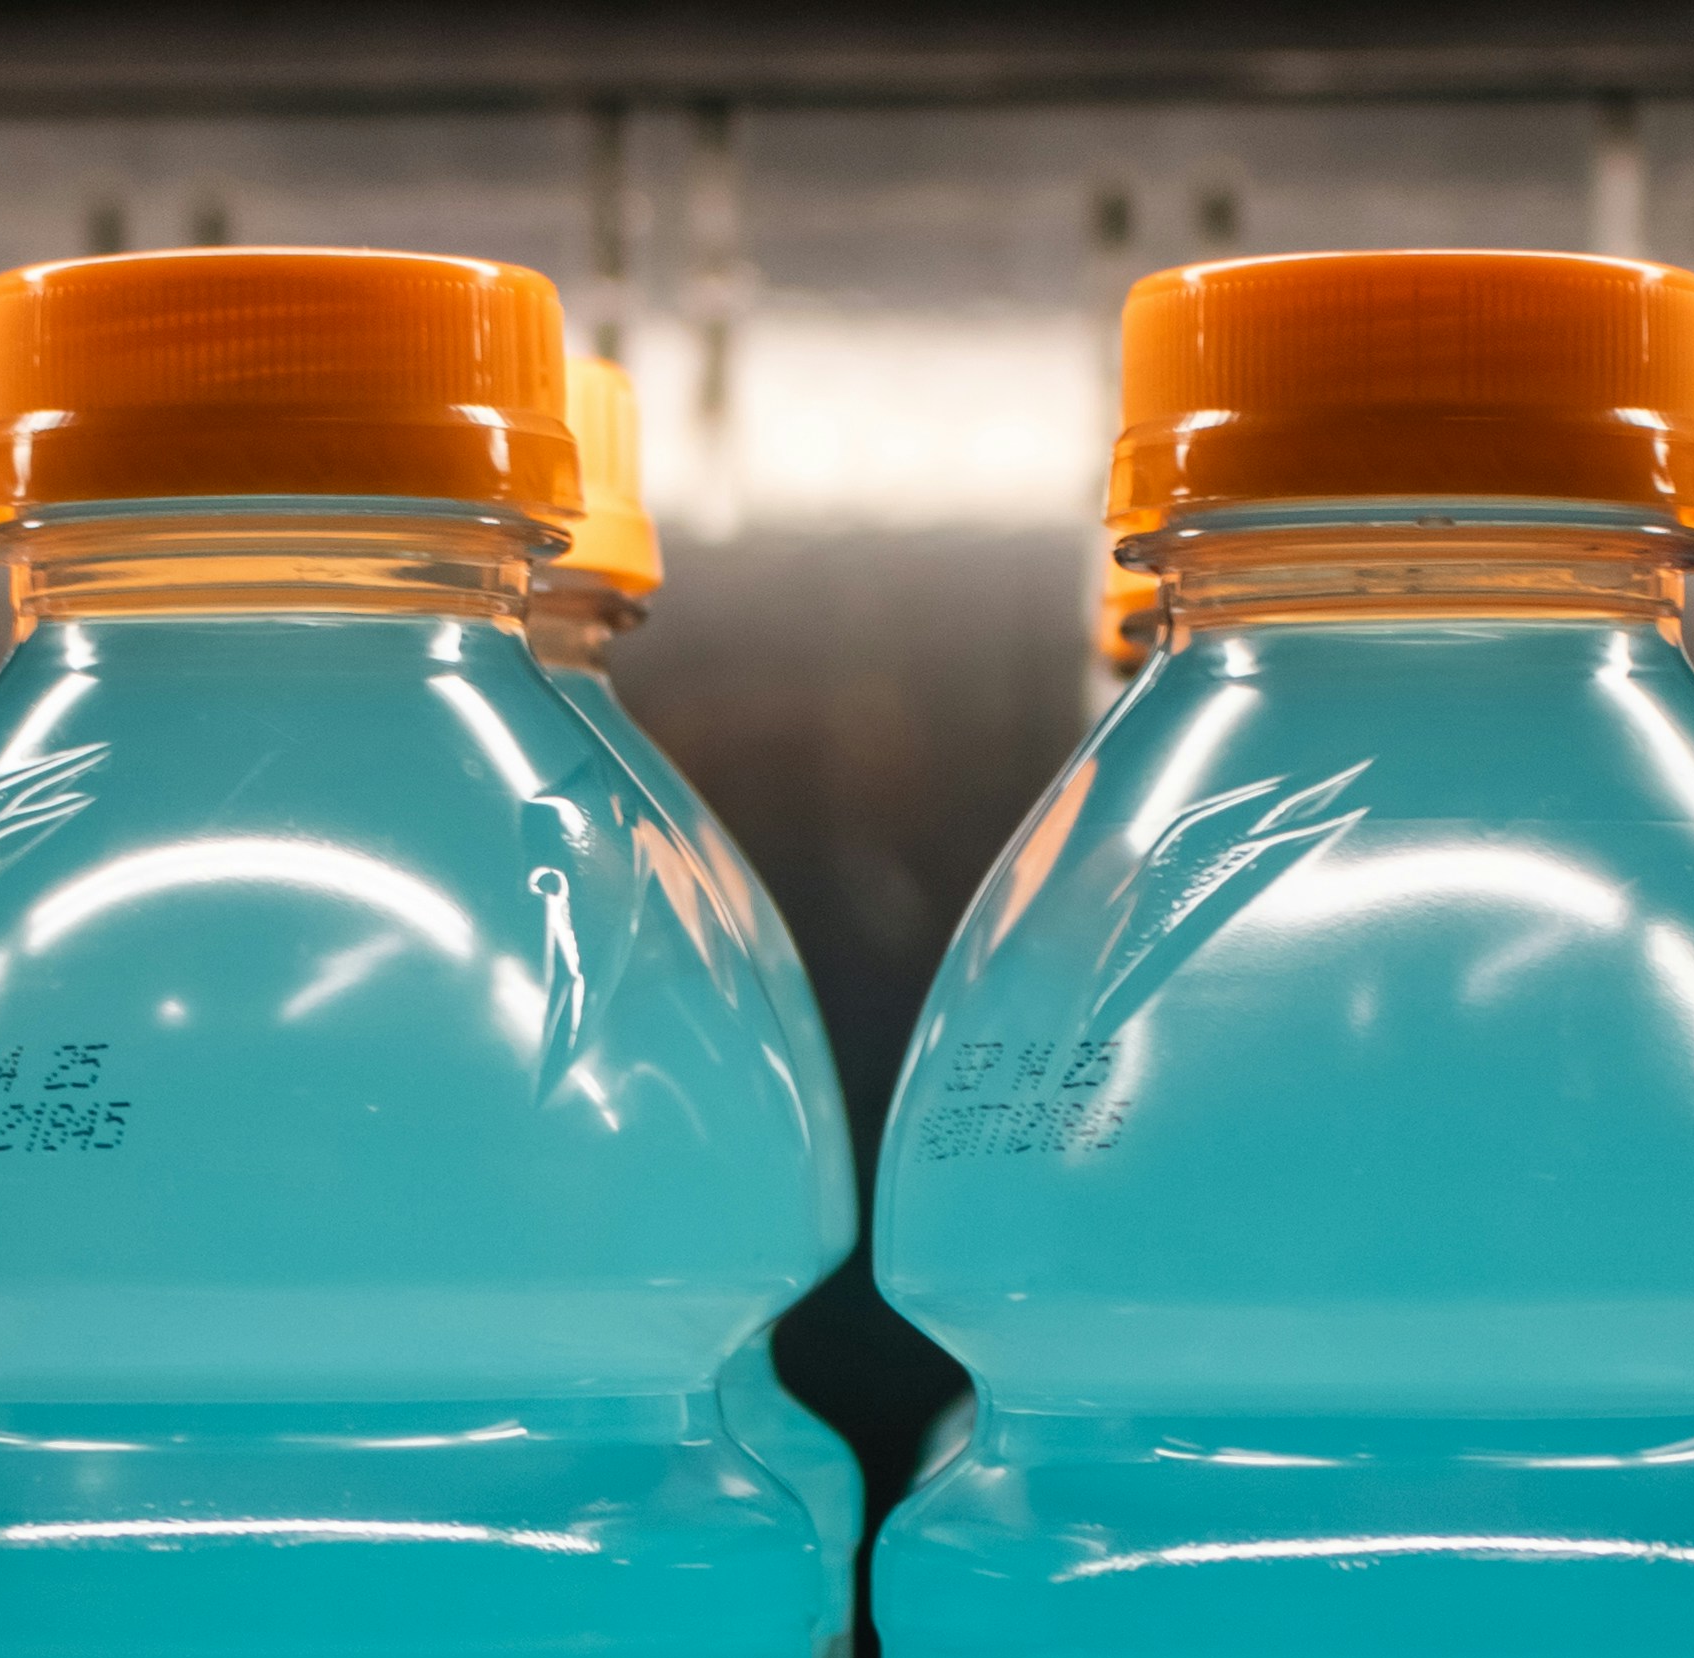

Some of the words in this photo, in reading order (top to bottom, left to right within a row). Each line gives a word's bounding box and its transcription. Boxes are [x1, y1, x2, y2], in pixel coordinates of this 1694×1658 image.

[43, 1043, 110, 1091] 25
[1011, 1041, 1055, 1092] 14
[1062, 1041, 1122, 1089] 25
